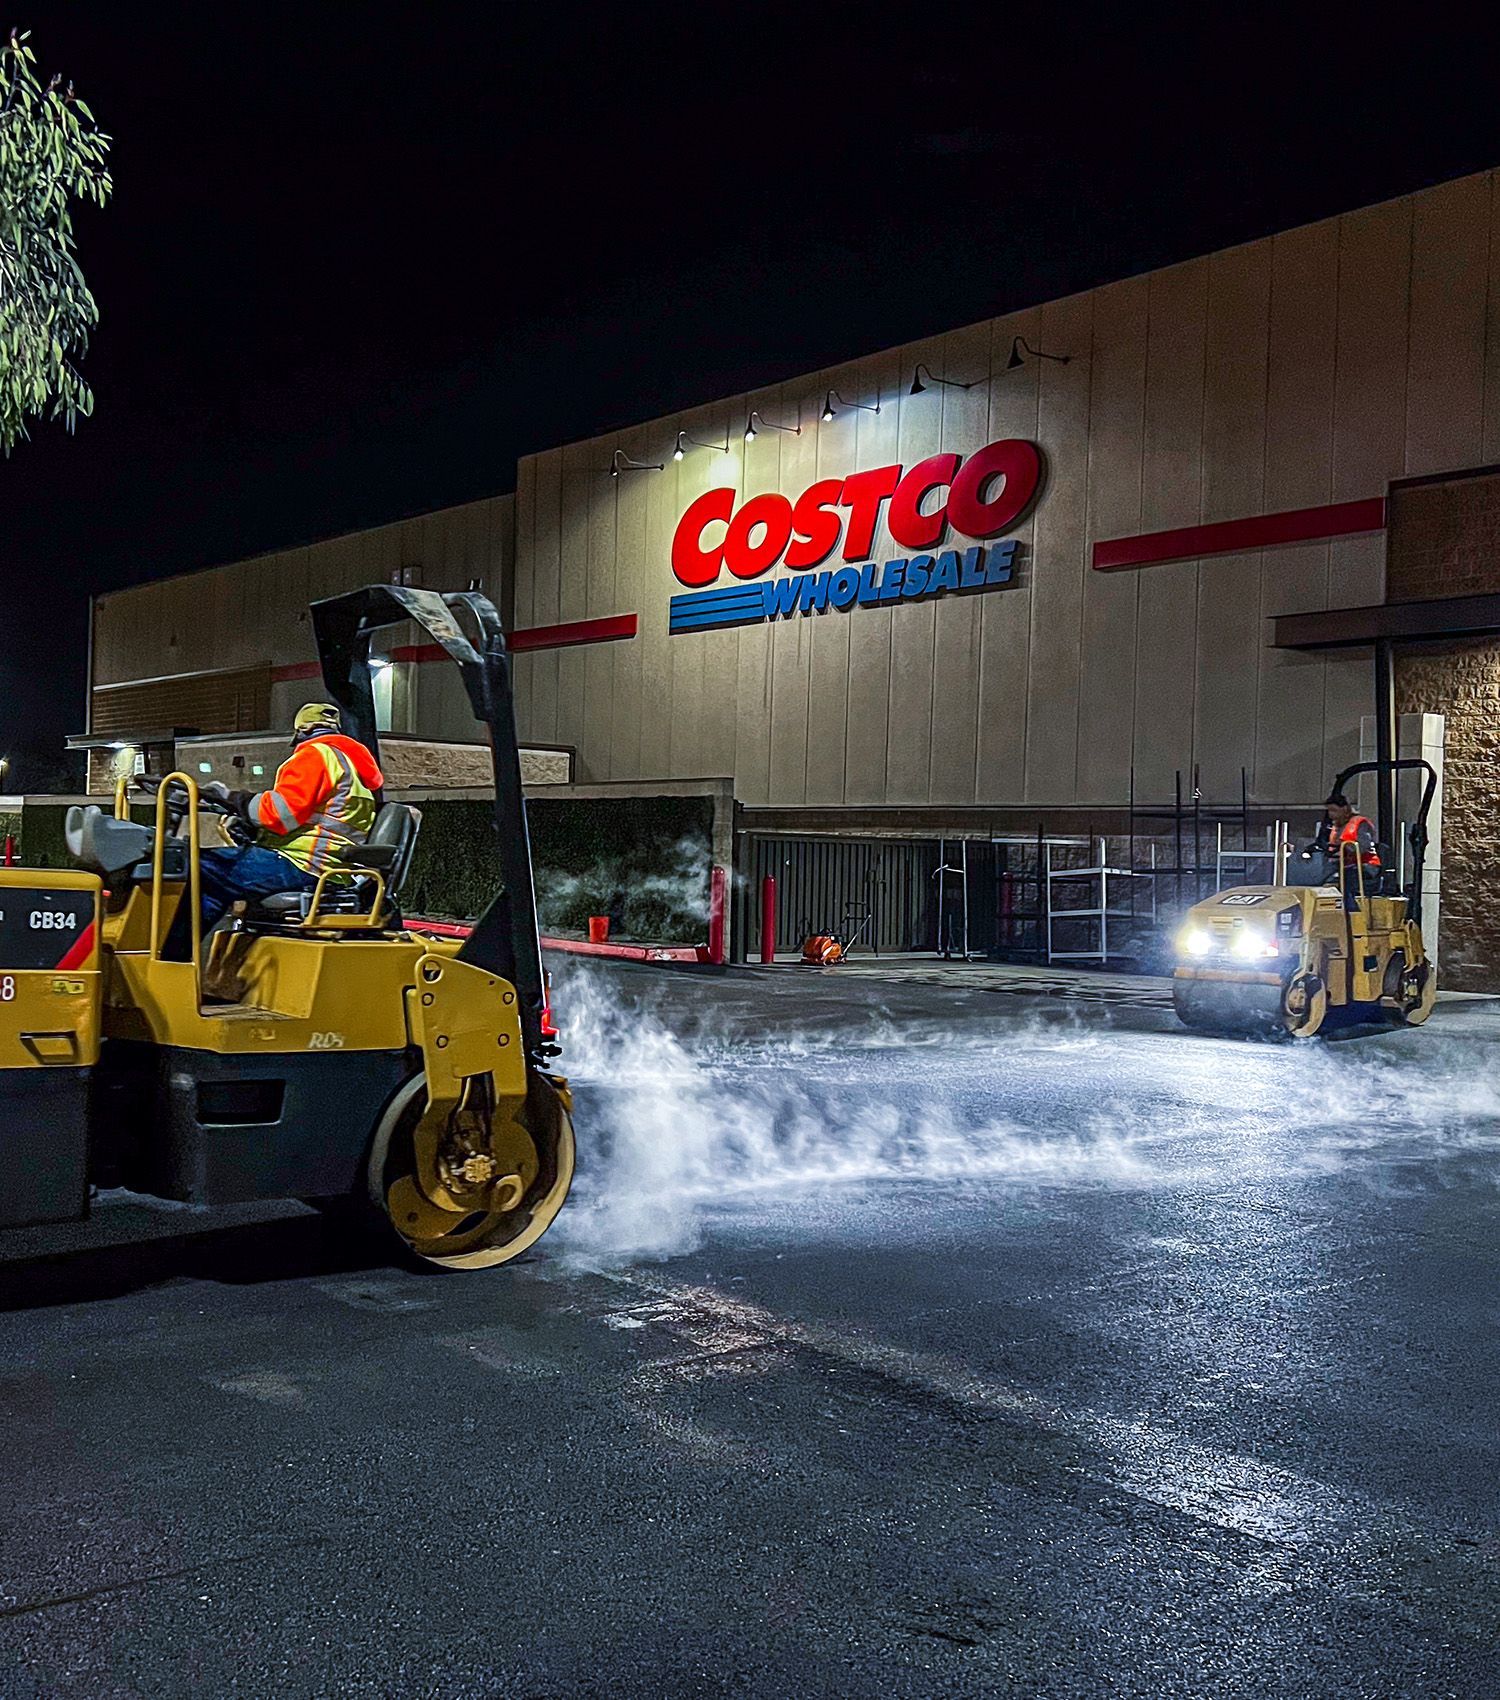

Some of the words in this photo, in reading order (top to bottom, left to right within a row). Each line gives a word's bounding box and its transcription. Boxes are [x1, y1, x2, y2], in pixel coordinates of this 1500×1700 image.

[671, 438, 1042, 588] COSTCO
[761, 541, 1019, 617] WHOLESALE
[1221, 895, 1267, 905] CAT
[29, 911, 76, 929] CB34
[0, 976, 15, 1001] 8
